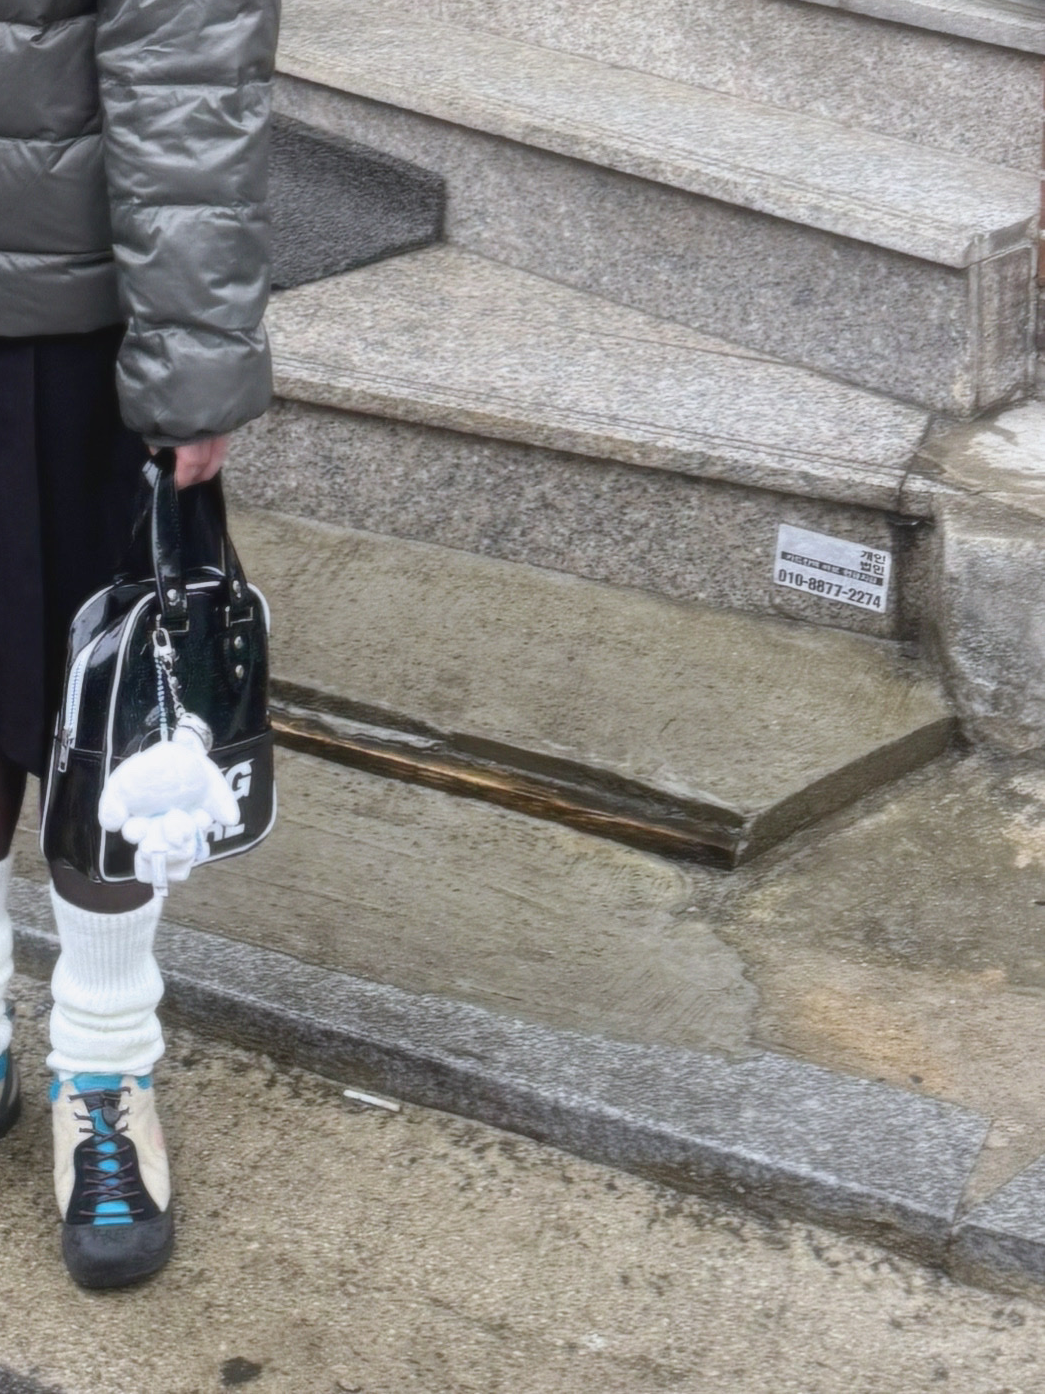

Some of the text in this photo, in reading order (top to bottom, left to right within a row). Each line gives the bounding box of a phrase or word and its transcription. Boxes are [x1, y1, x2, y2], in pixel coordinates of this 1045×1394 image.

[860, 550, 886, 565] 개인
[860, 561, 884, 576] 법인
[778, 568, 882, 608] 010-8877-2274
